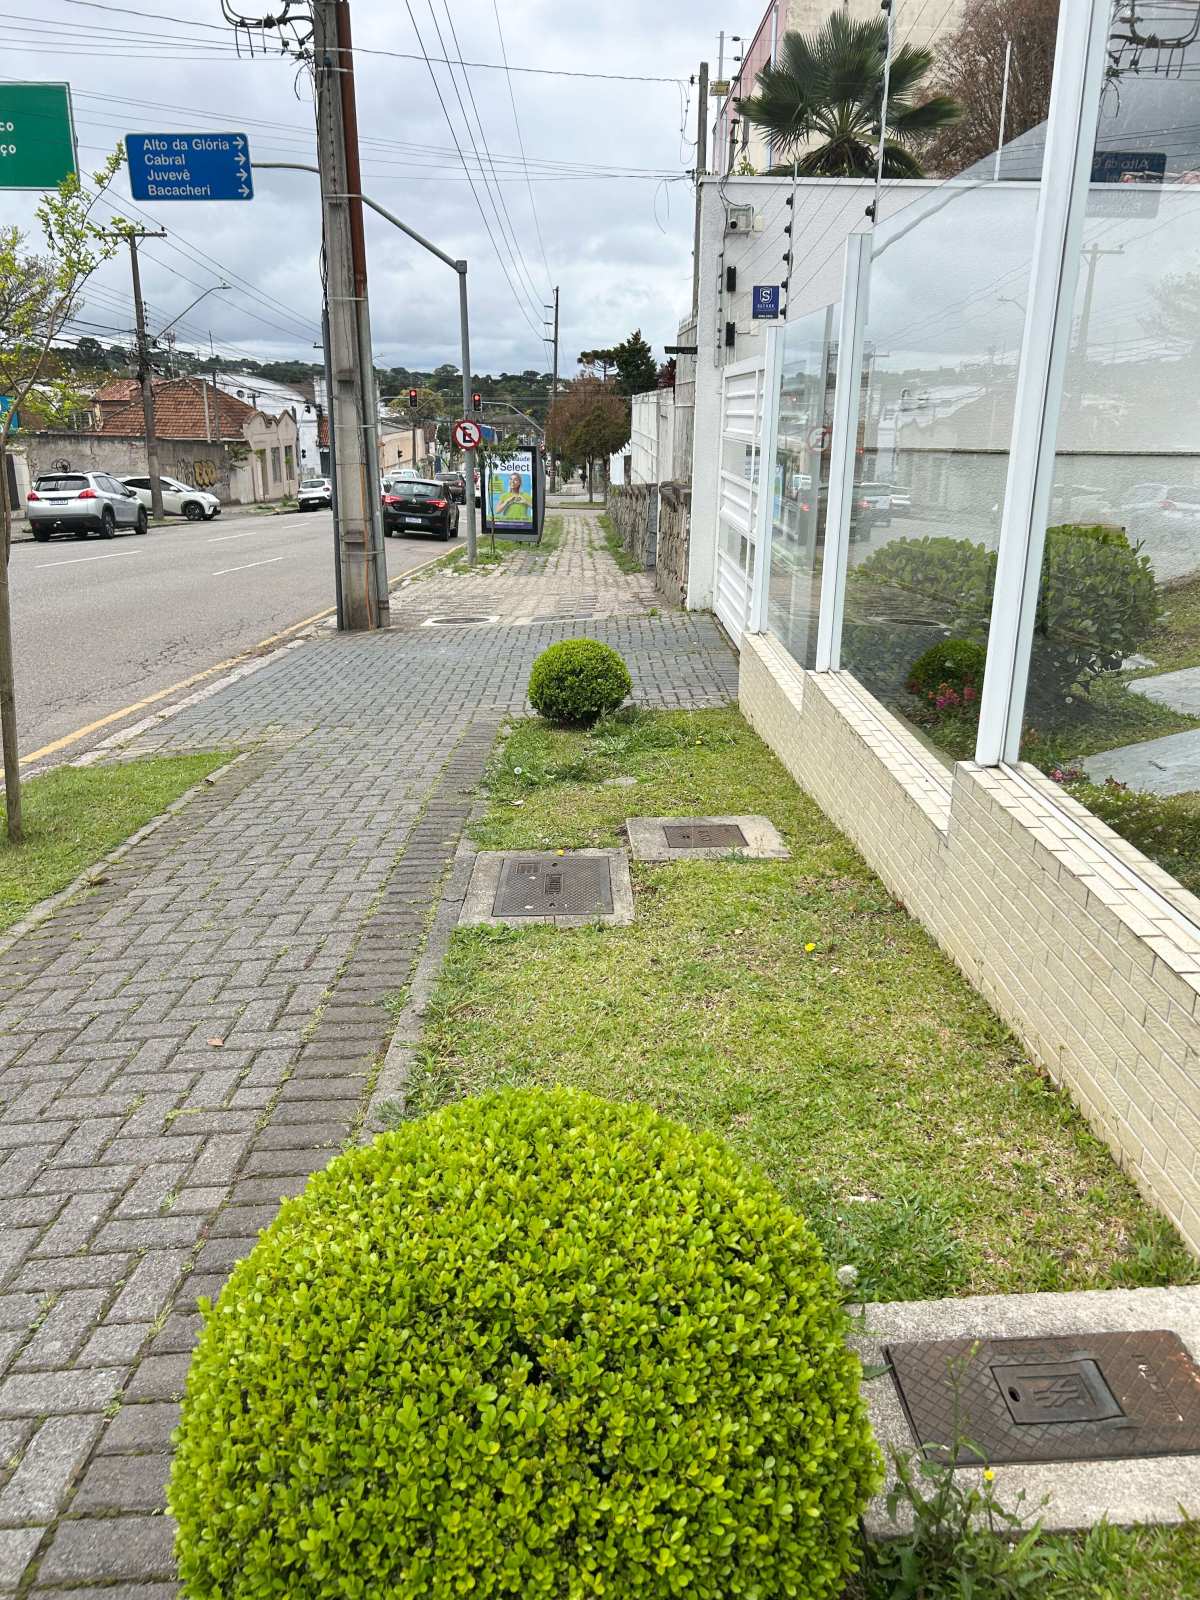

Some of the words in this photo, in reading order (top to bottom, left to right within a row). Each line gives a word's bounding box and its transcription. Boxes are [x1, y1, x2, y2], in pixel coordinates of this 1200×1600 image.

[143, 138, 168, 151] Alto
[172, 138, 188, 151] da
[192, 138, 230, 151] Glória
[144, 153, 186, 166] Cabral
[147, 168, 191, 181] Juvevê
[147, 184, 211, 196] Bacacheri
[500, 462, 531, 472] Select
